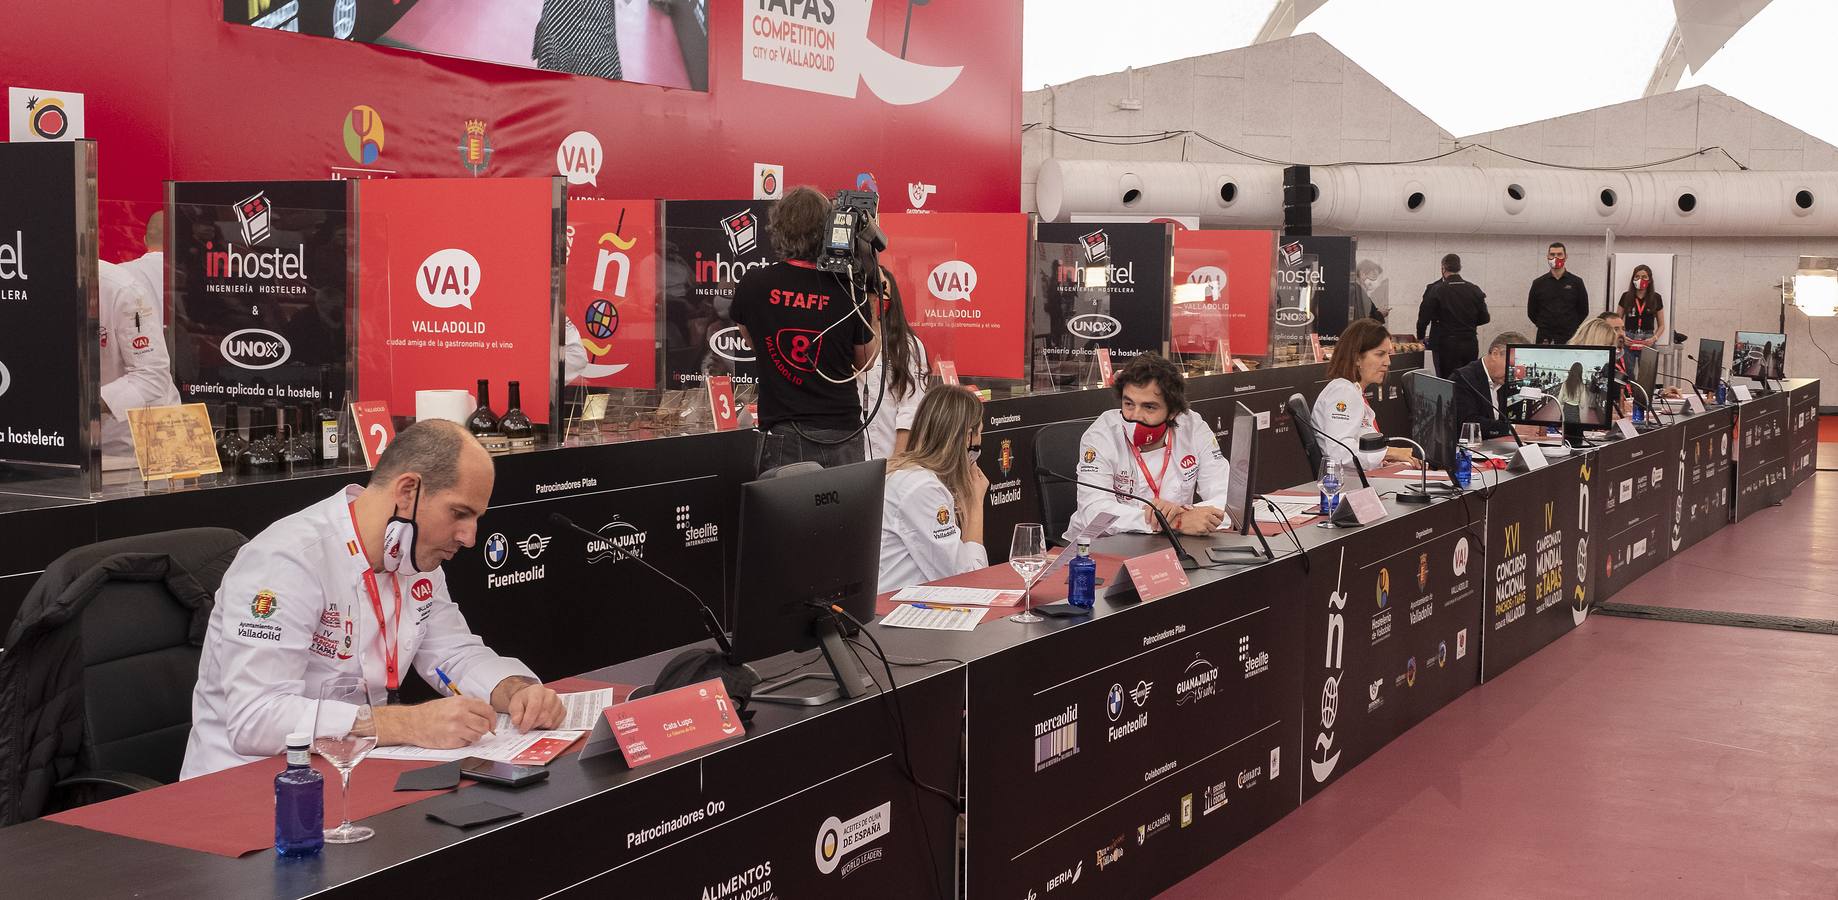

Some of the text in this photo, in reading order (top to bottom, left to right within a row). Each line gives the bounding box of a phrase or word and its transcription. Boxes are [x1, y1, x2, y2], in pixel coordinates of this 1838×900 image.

[752, 15, 835, 50] COMPETITION
[752, 46, 835, 72] CITY OF VALLADOLID
[562, 145, 597, 174] VA!
[206, 241, 307, 280] inhostel
[1057, 259, 1135, 284] inhstel
[206, 284, 307, 294] INGENIERÍA HOSTELERA
[423, 265, 470, 295] VA!
[933, 271, 970, 293] VA!
[695, 288, 735, 296] INGENIER
[769, 288, 830, 311] STAFF
[252, 305, 259, 315] &
[924, 309, 982, 318] VALLADOLID
[411, 320, 486, 334] VALLADOLID
[1073, 321, 1112, 333] UNOX
[228, 340, 279, 358] UNOX
[407, 339, 427, 348] amiga
[428, 339, 436, 347] de
[437, 339, 443, 347] la
[486, 342, 491, 350] y
[500, 341, 514, 349] vino
[183, 382, 322, 398] ingeniería aplicada a la hostele
[719, 394, 731, 419] 3
[990, 414, 1021, 426] Organizadores
[8, 426, 65, 447] hostelería
[370, 424, 388, 455] 2
[535, 477, 597, 494] Patrocinadores Plata
[990, 478, 1021, 492] Ayuntamiento de
[814, 490, 839, 506] BenQ
[990, 488, 1021, 506] Valladolid
[1545, 501, 1554, 532] IV
[685, 522, 718, 541] steelite
[685, 536, 719, 547] INTERNATIONAL
[1504, 521, 1520, 558] XVI
[1536, 530, 1562, 554] CAMPEONATO
[528, 542, 541, 550] MINI
[1454, 547, 1467, 569] VA!
[1496, 552, 1527, 582] CONCURSO
[1536, 545, 1563, 577] MUNDIAL
[488, 564, 545, 589] Fuenteolid
[1536, 567, 1562, 601] DE TAPAS
[412, 583, 431, 598] VA!
[1495, 572, 1527, 604] NACIONAL
[1410, 602, 1433, 625] Valladolid
[1505, 603, 1526, 625] VALLADOLID
[238, 628, 281, 642] Valladolid
[239, 621, 274, 630] Ayuntamiento
[1143, 624, 1186, 646] Patrocinadores Plata
[1245, 651, 1269, 673] steelite
[1176, 667, 1218, 695] GUANAJUATO
[663, 717, 693, 731] Cata Lupo
[1034, 703, 1078, 737] mercaolid
[1108, 711, 1148, 742] Fuenteolid
[1144, 760, 1177, 782] Colaboradores
[1237, 766, 1261, 789] Cámara
[626, 799, 725, 849] Patrocinadores Oro
[843, 811, 881, 835] ACEITES DE OLIVA
[843, 822, 881, 849] DE ESPAÑA
[841, 849, 882, 877] WORLD LEADERS
[701, 860, 771, 900] ALIMENTOS
[1046, 868, 1073, 893] IBERIA
